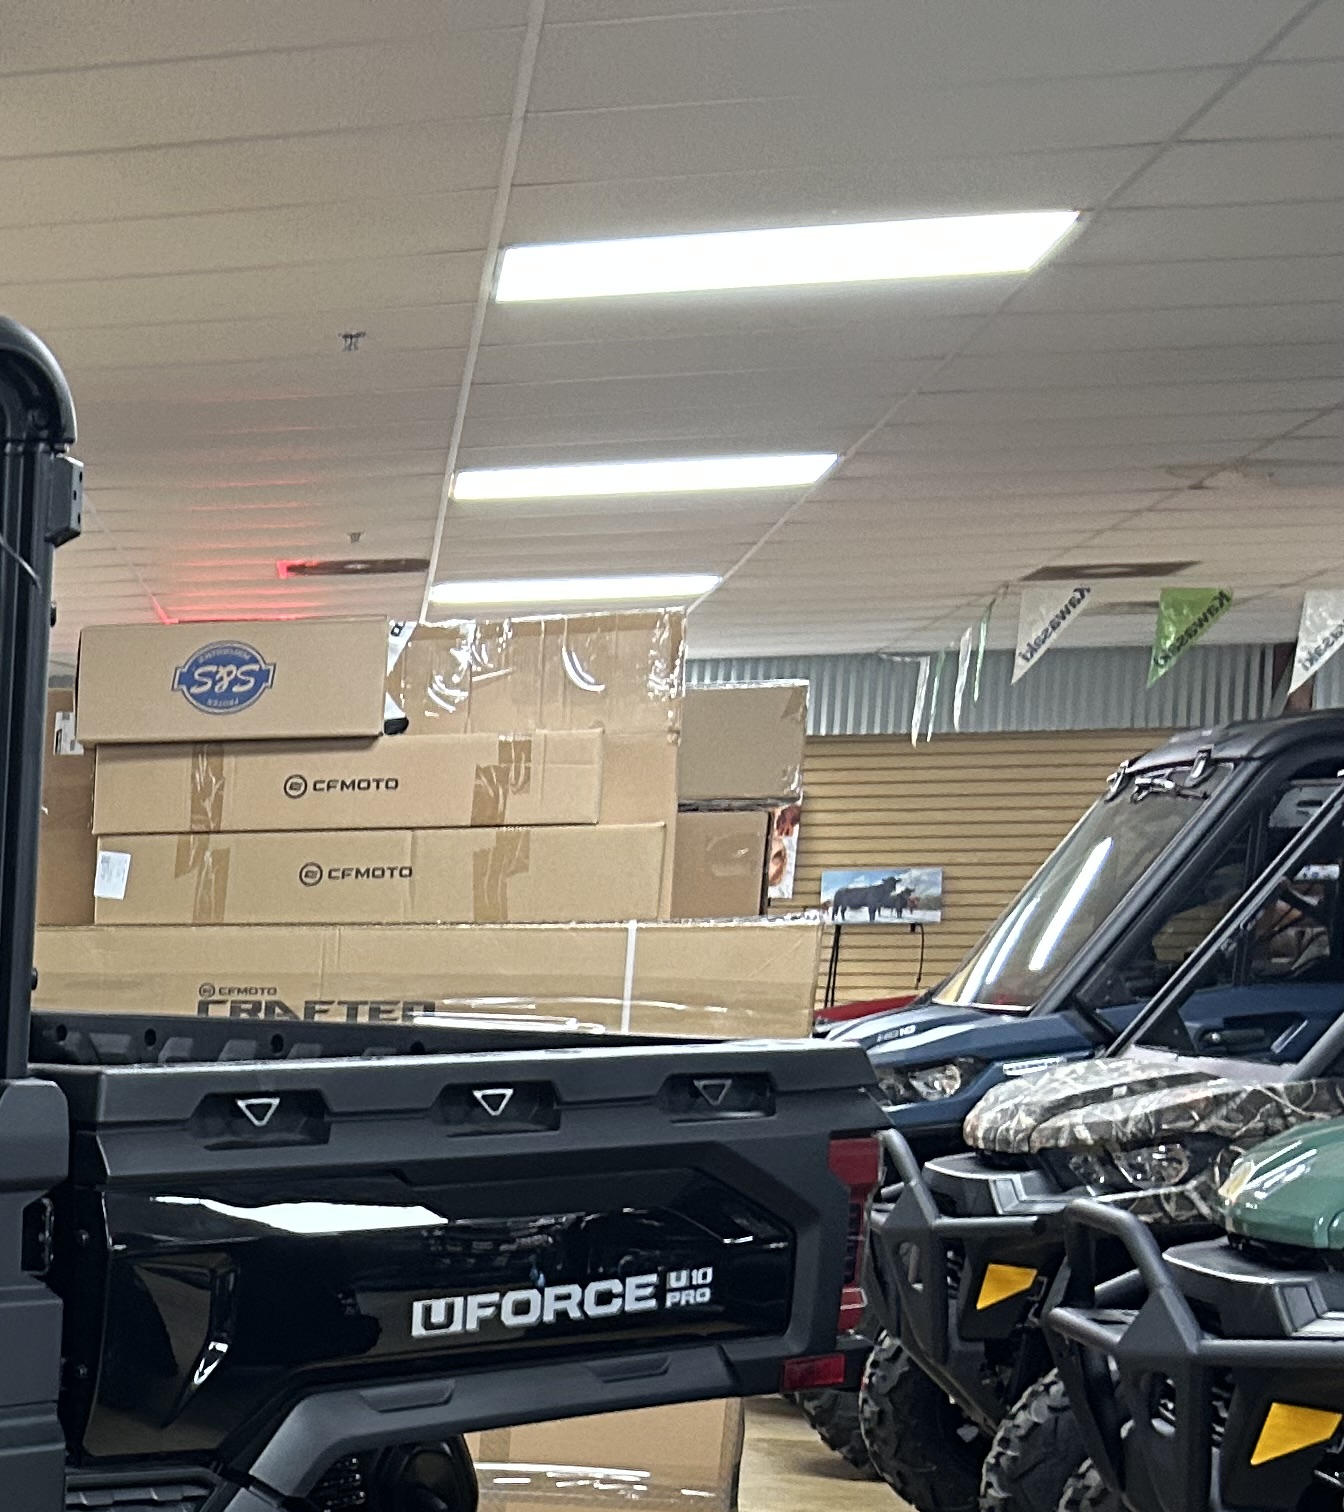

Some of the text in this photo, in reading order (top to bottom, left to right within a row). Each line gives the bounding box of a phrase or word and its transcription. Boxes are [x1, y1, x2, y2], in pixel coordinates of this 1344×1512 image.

[189, 663, 260, 694] S&S
[312, 777, 399, 792] CFMOTO
[327, 866, 413, 881] CFMOTO
[218, 986, 278, 996] CFMOTO
[667, 1266, 712, 1289] U10
[665, 1287, 712, 1308] PRO
